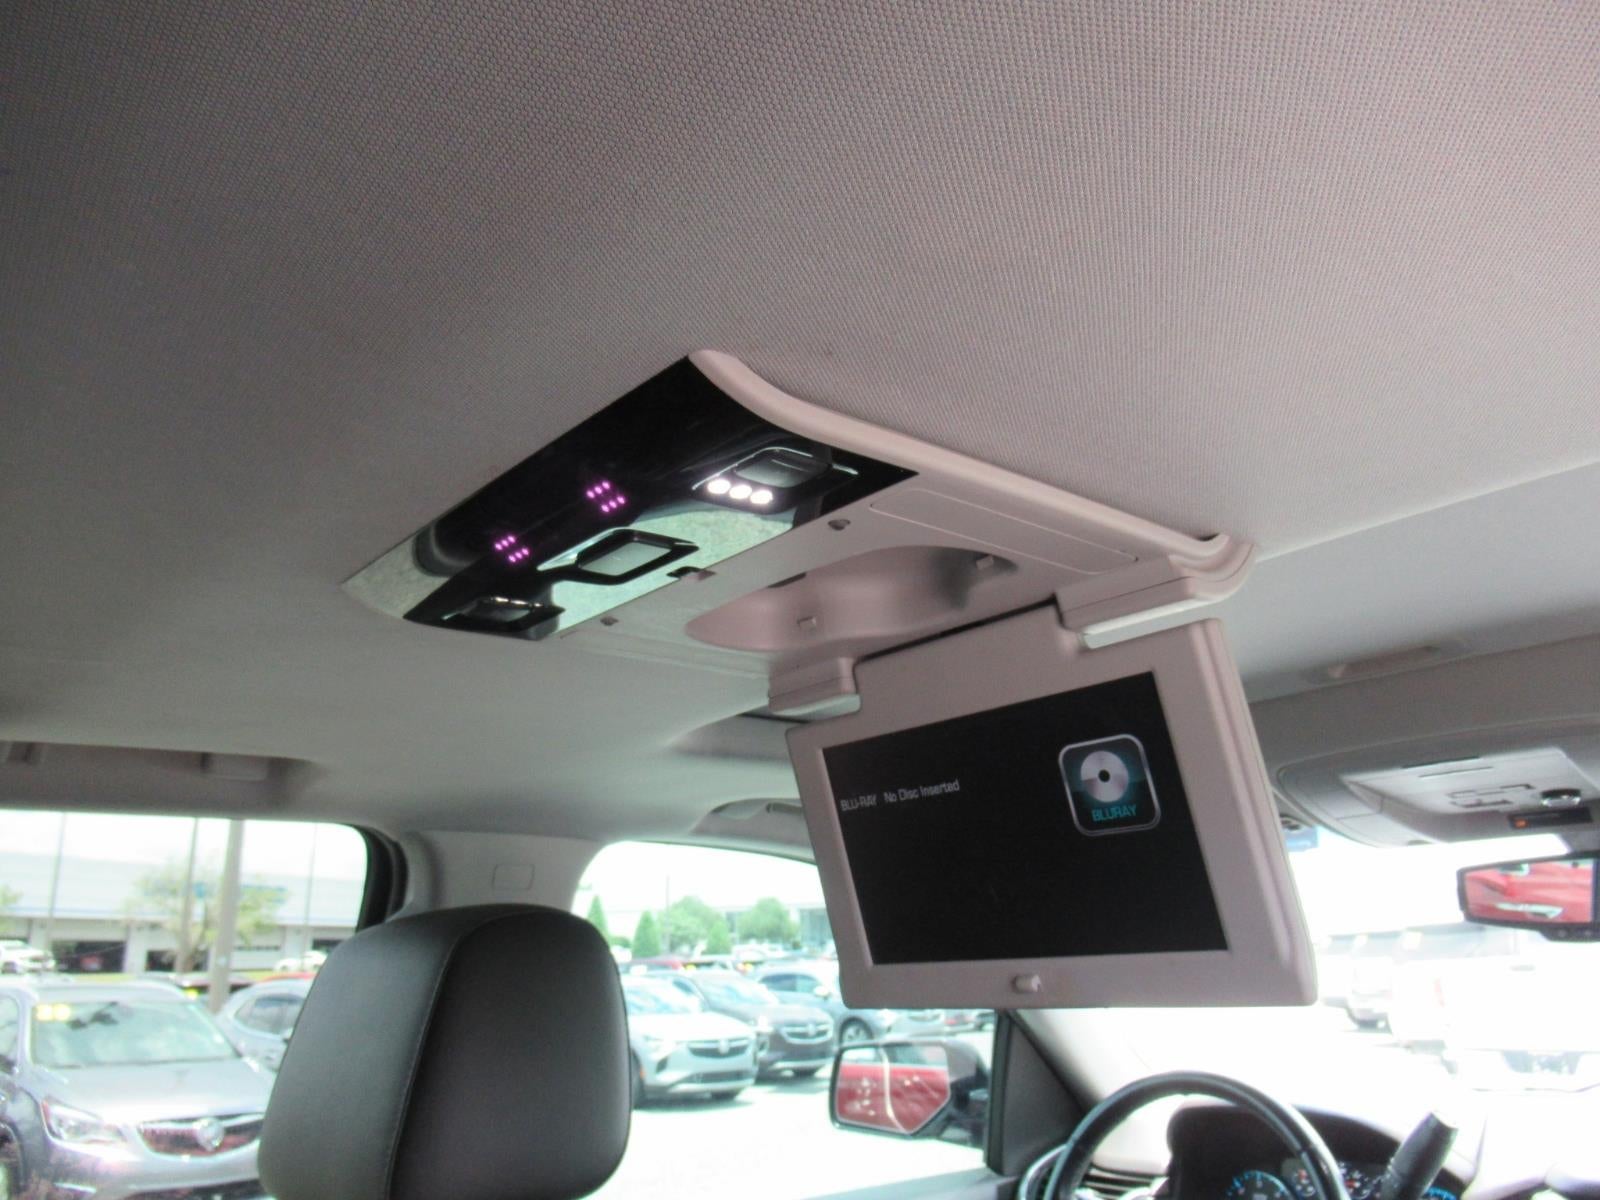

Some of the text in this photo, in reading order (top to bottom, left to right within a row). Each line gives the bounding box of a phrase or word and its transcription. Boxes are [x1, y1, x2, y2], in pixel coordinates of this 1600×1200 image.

[840, 779, 960, 812] BLU-RAY No Disc Inserted
[1091, 804, 1137, 822] BLURAY
